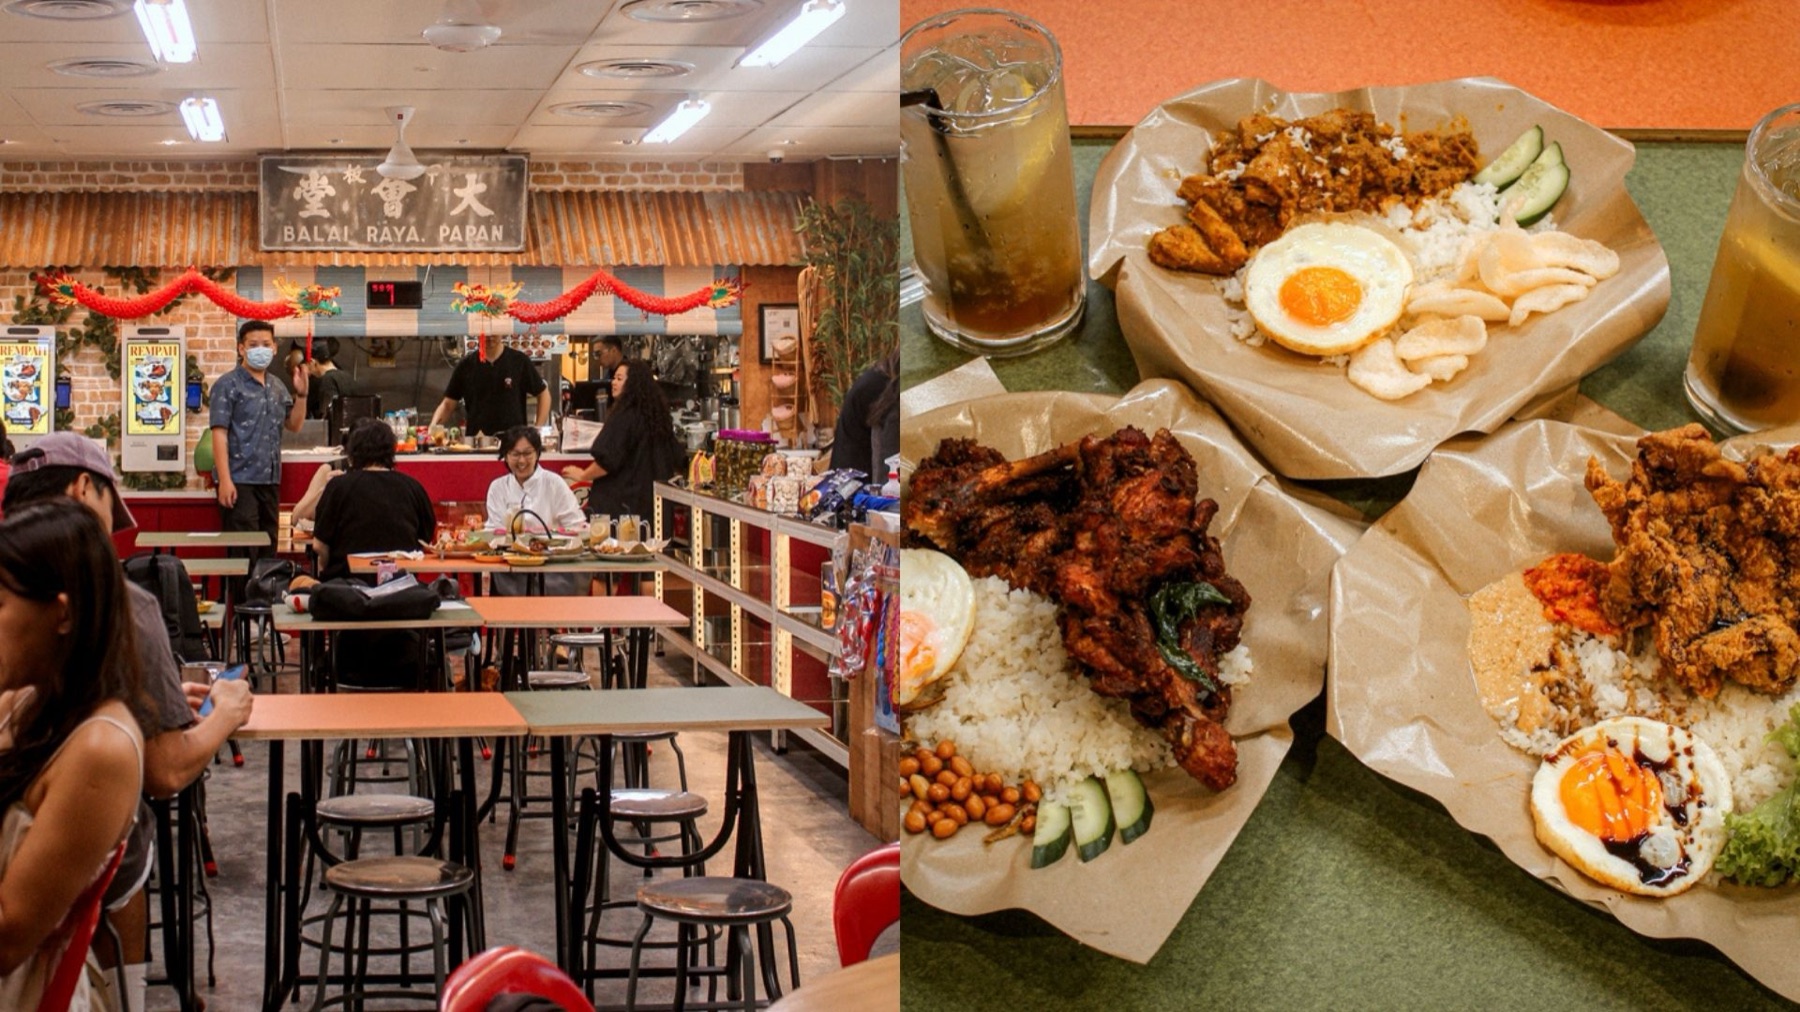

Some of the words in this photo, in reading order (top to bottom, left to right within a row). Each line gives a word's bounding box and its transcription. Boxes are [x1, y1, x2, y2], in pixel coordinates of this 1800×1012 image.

[283, 226, 349, 243] BALAI
[439, 225, 504, 242] PAPAN
[0, 345, 47, 356] REMPAH
[130, 346, 177, 356] REMPAH
